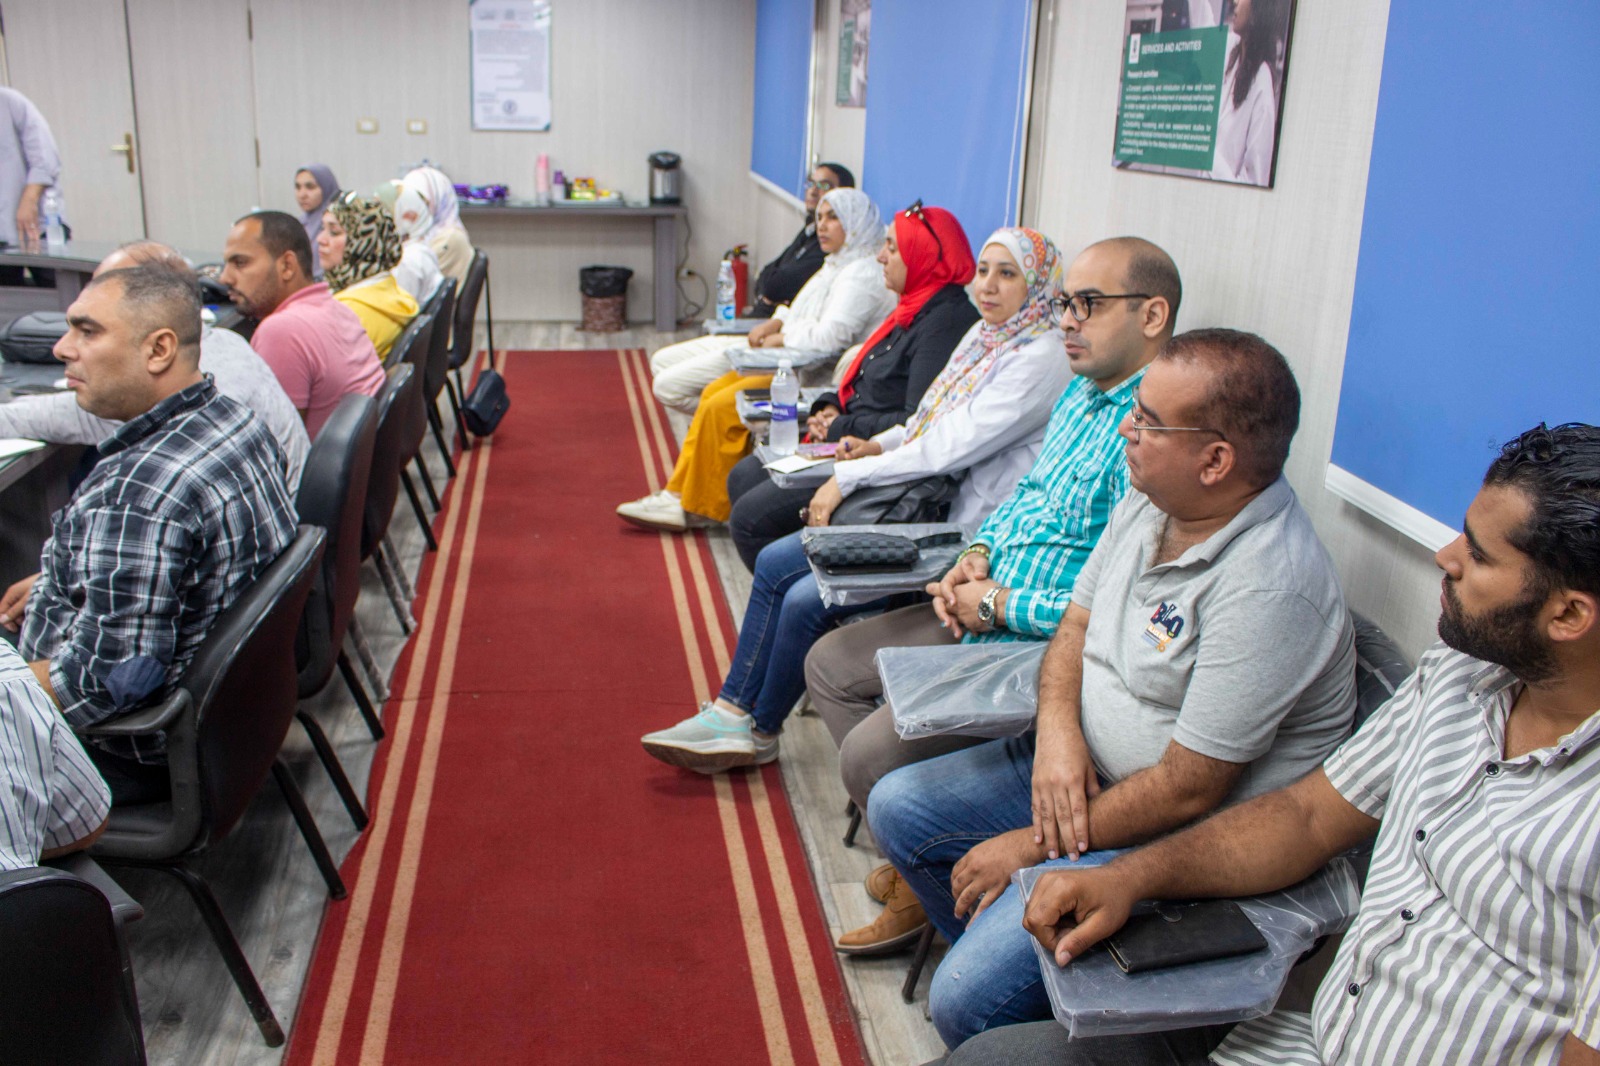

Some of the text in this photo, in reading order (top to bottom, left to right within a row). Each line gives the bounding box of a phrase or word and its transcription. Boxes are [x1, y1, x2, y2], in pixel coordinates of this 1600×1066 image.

[1141, 42, 1164, 55] SERVICES
[1164, 42, 1175, 53] AND
[1175, 40, 1202, 53] ACTIVITIES
